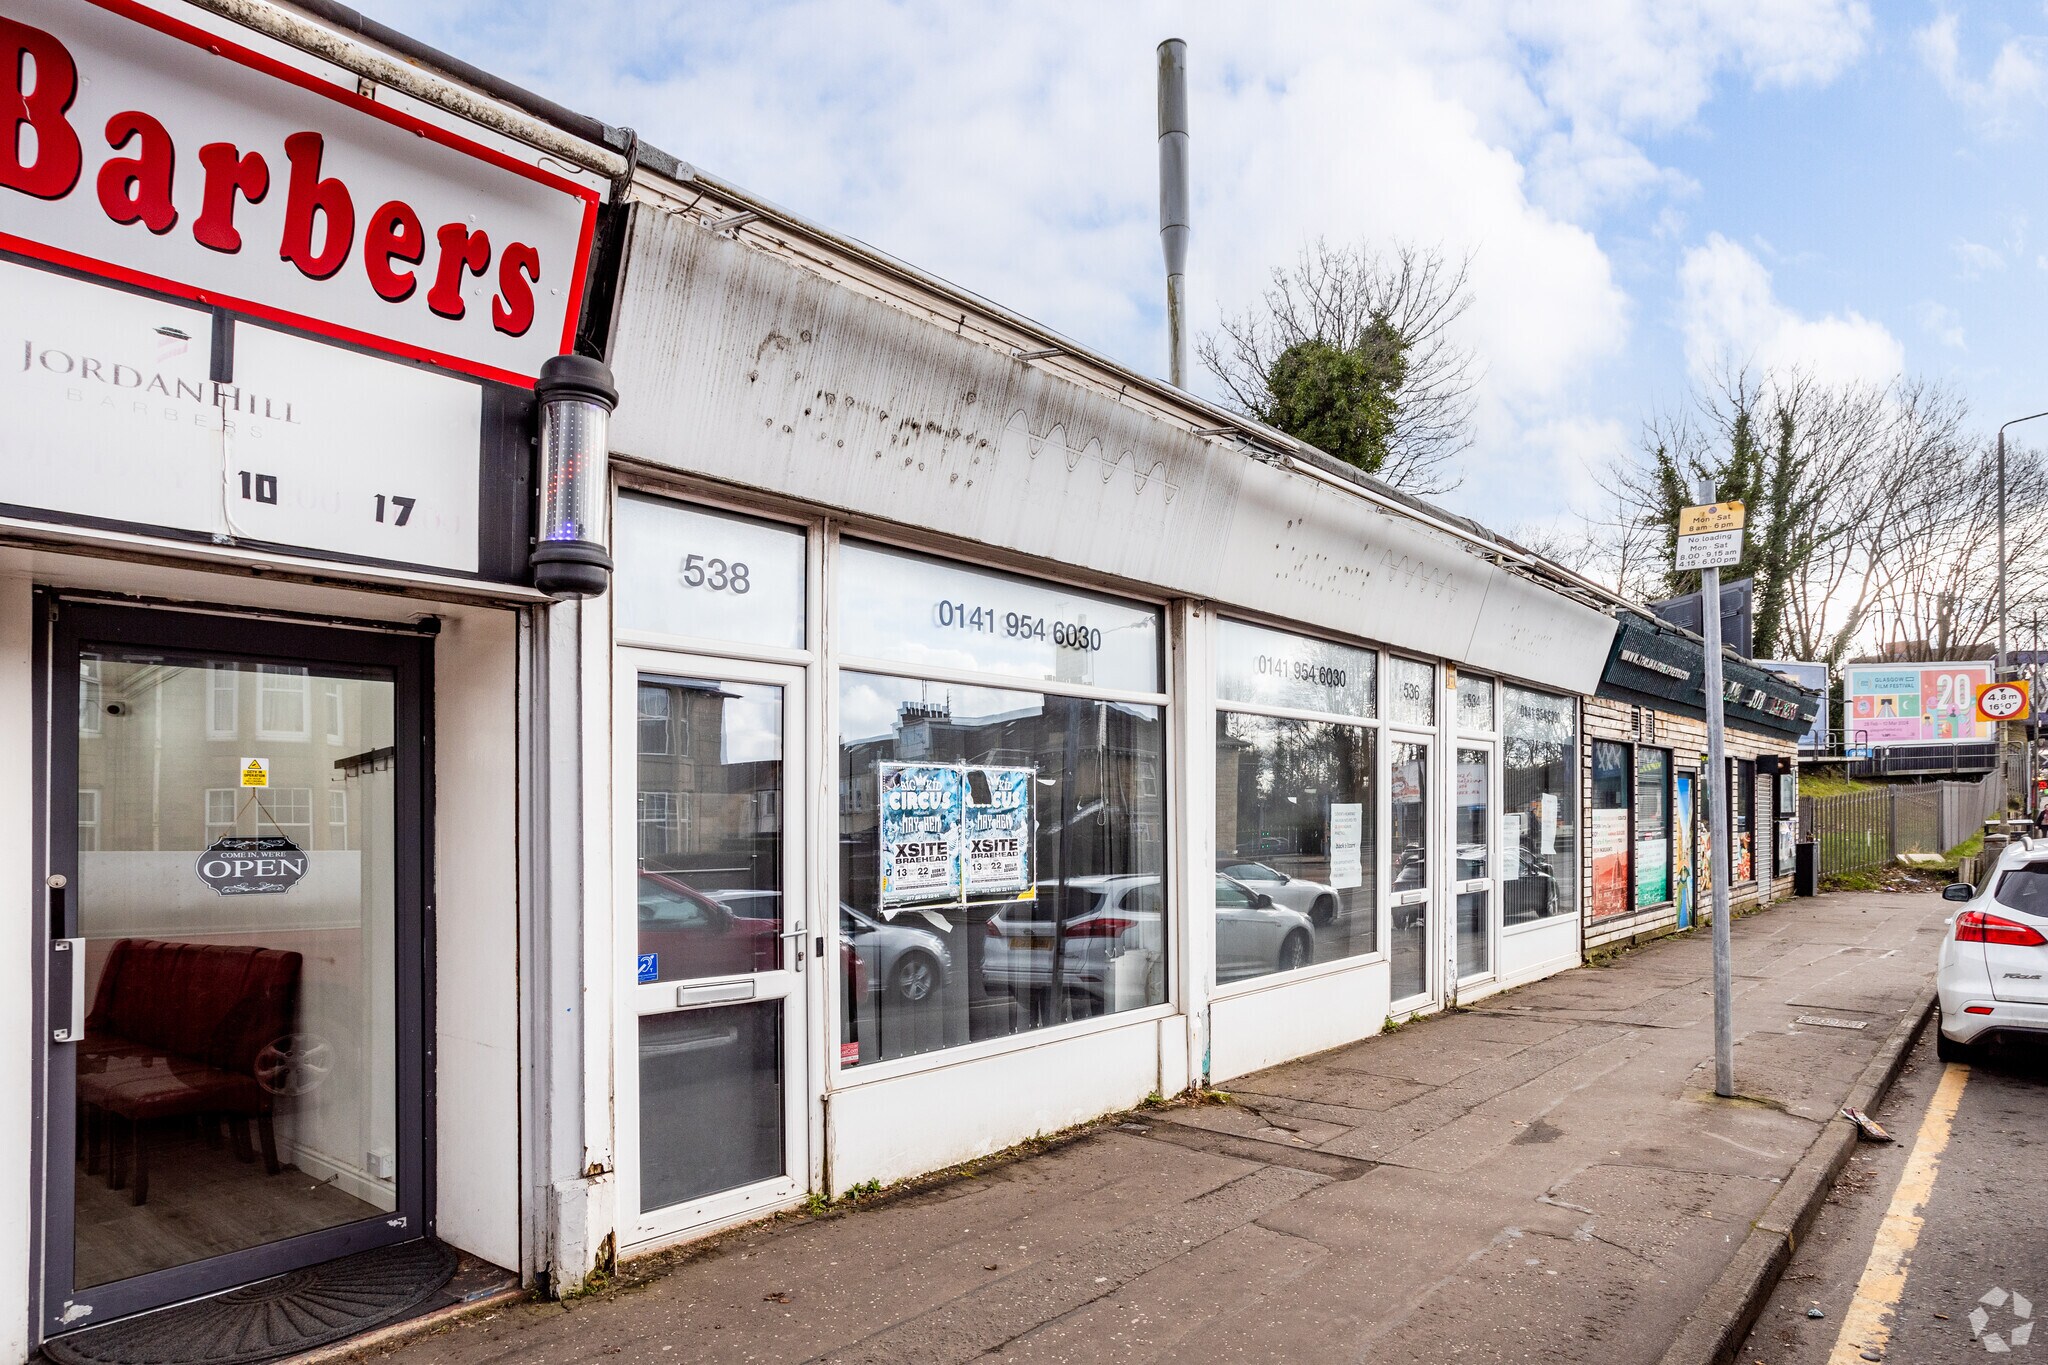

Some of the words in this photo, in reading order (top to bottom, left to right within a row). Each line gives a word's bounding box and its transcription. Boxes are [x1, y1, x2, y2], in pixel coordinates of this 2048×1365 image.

[0, 17, 541, 338] Barbers
[20, 340, 301, 425] JORDANHILL
[237, 470, 278, 505] 10
[373, 493, 417, 527] 17
[1720, 522, 1734, 530] pm
[1702, 534, 1732, 542] loading
[682, 554, 751, 595] 538
[938, 600, 995, 633] 0141
[1005, 612, 1046, 642] 954
[1053, 620, 1102, 652] 6030
[1258, 655, 1289, 678] 0141
[1294, 661, 1316, 681] 954
[1318, 666, 1347, 688] 6030
[1403, 682, 1421, 701] 536
[1937, 674, 1970, 709] 20
[926, 777, 943, 790] KID
[998, 777, 1013, 790] KID
[889, 791, 952, 810] CIRCUS
[895, 842, 948, 858] XSITE
[971, 839, 1018, 852] XSITE
[203, 859, 305, 878] OPEN
[895, 856, 948, 864] BRAEHEAD
[897, 868, 907, 876] 13
[917, 867, 928, 875] 22
